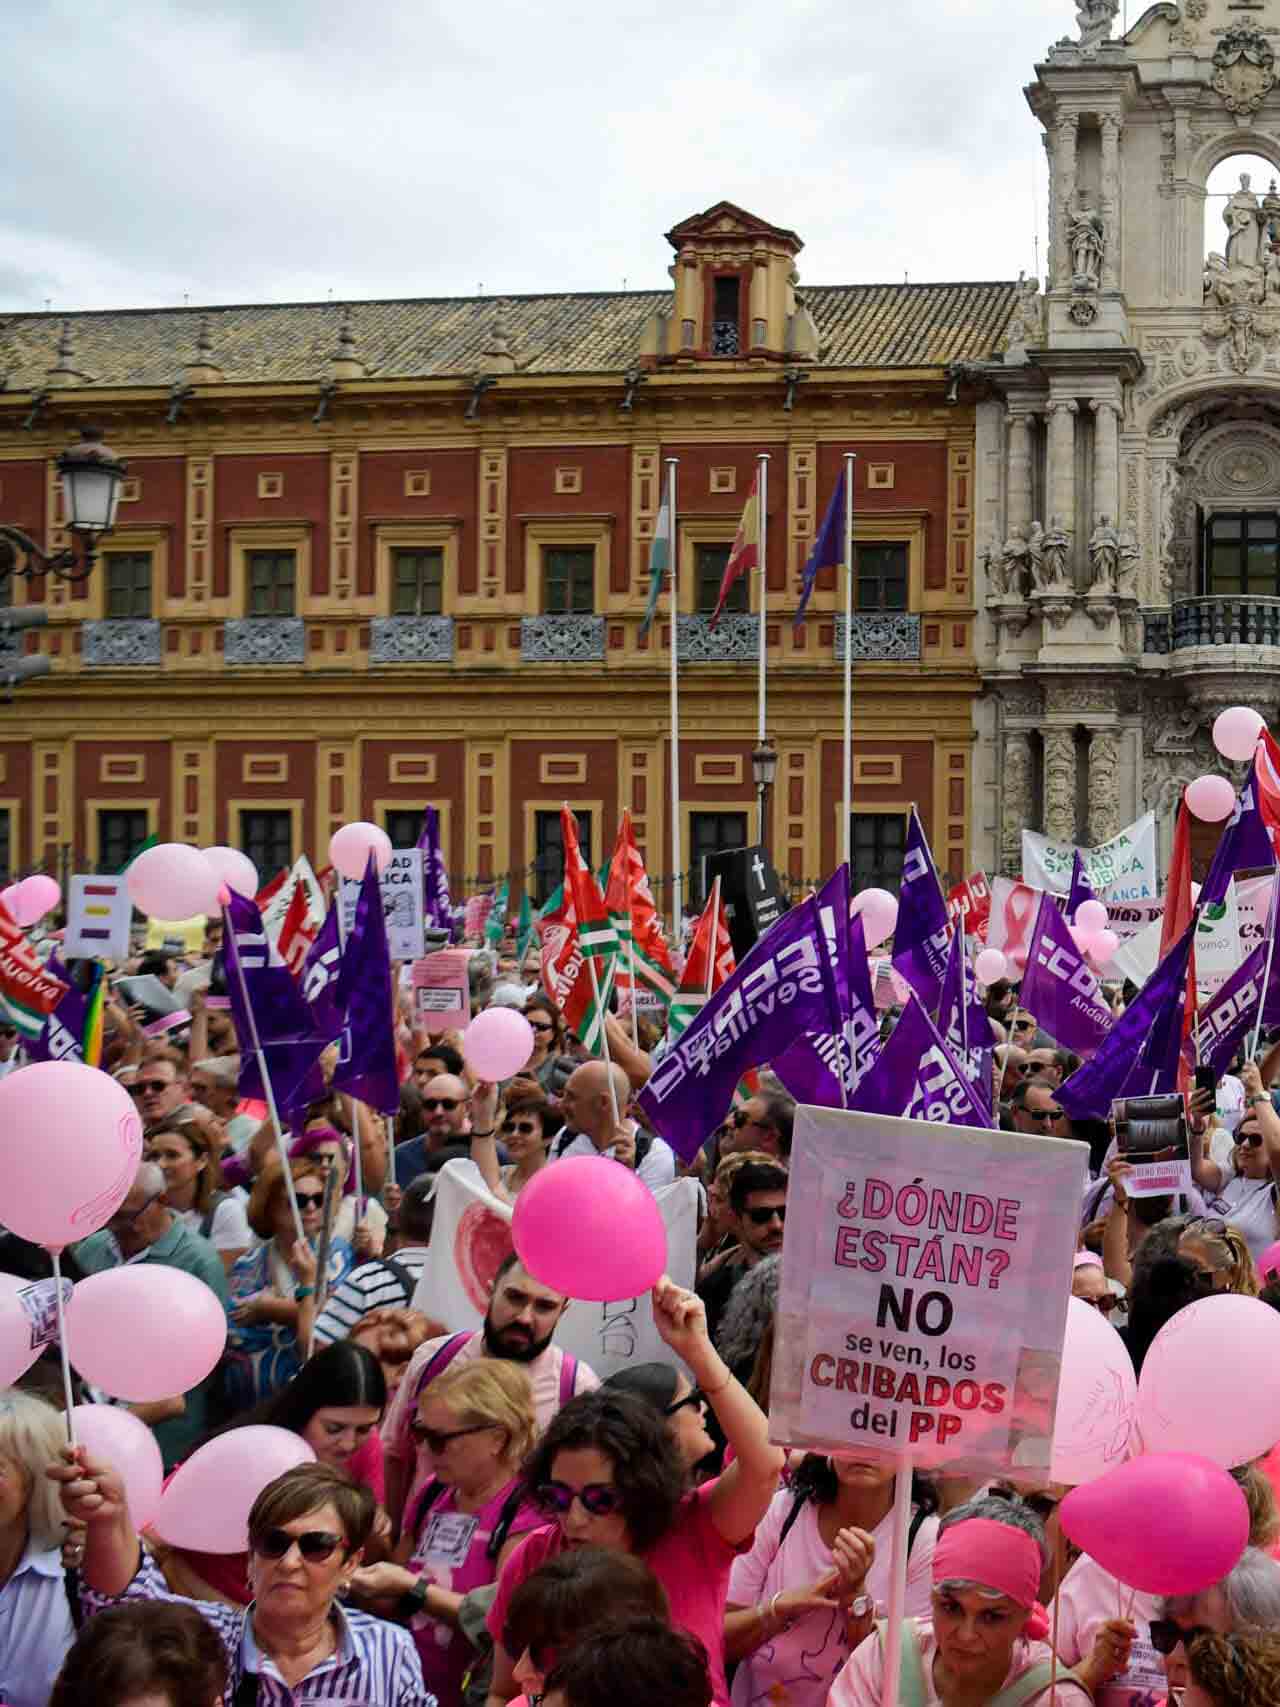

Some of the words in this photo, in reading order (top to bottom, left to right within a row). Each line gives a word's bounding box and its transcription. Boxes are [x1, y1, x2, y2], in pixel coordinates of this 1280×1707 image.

[836, 1177, 1020, 1241] ¿DÓNDE
[835, 1226, 1011, 1289] ESTÁN?
[876, 1282, 954, 1337] NO
[845, 1331, 873, 1355] se
[879, 1338, 930, 1371] ven,
[940, 1344, 977, 1373] los
[809, 1352, 1007, 1414] CRIBADOS
[850, 1402, 896, 1438] del
[909, 1410, 962, 1444] PP
